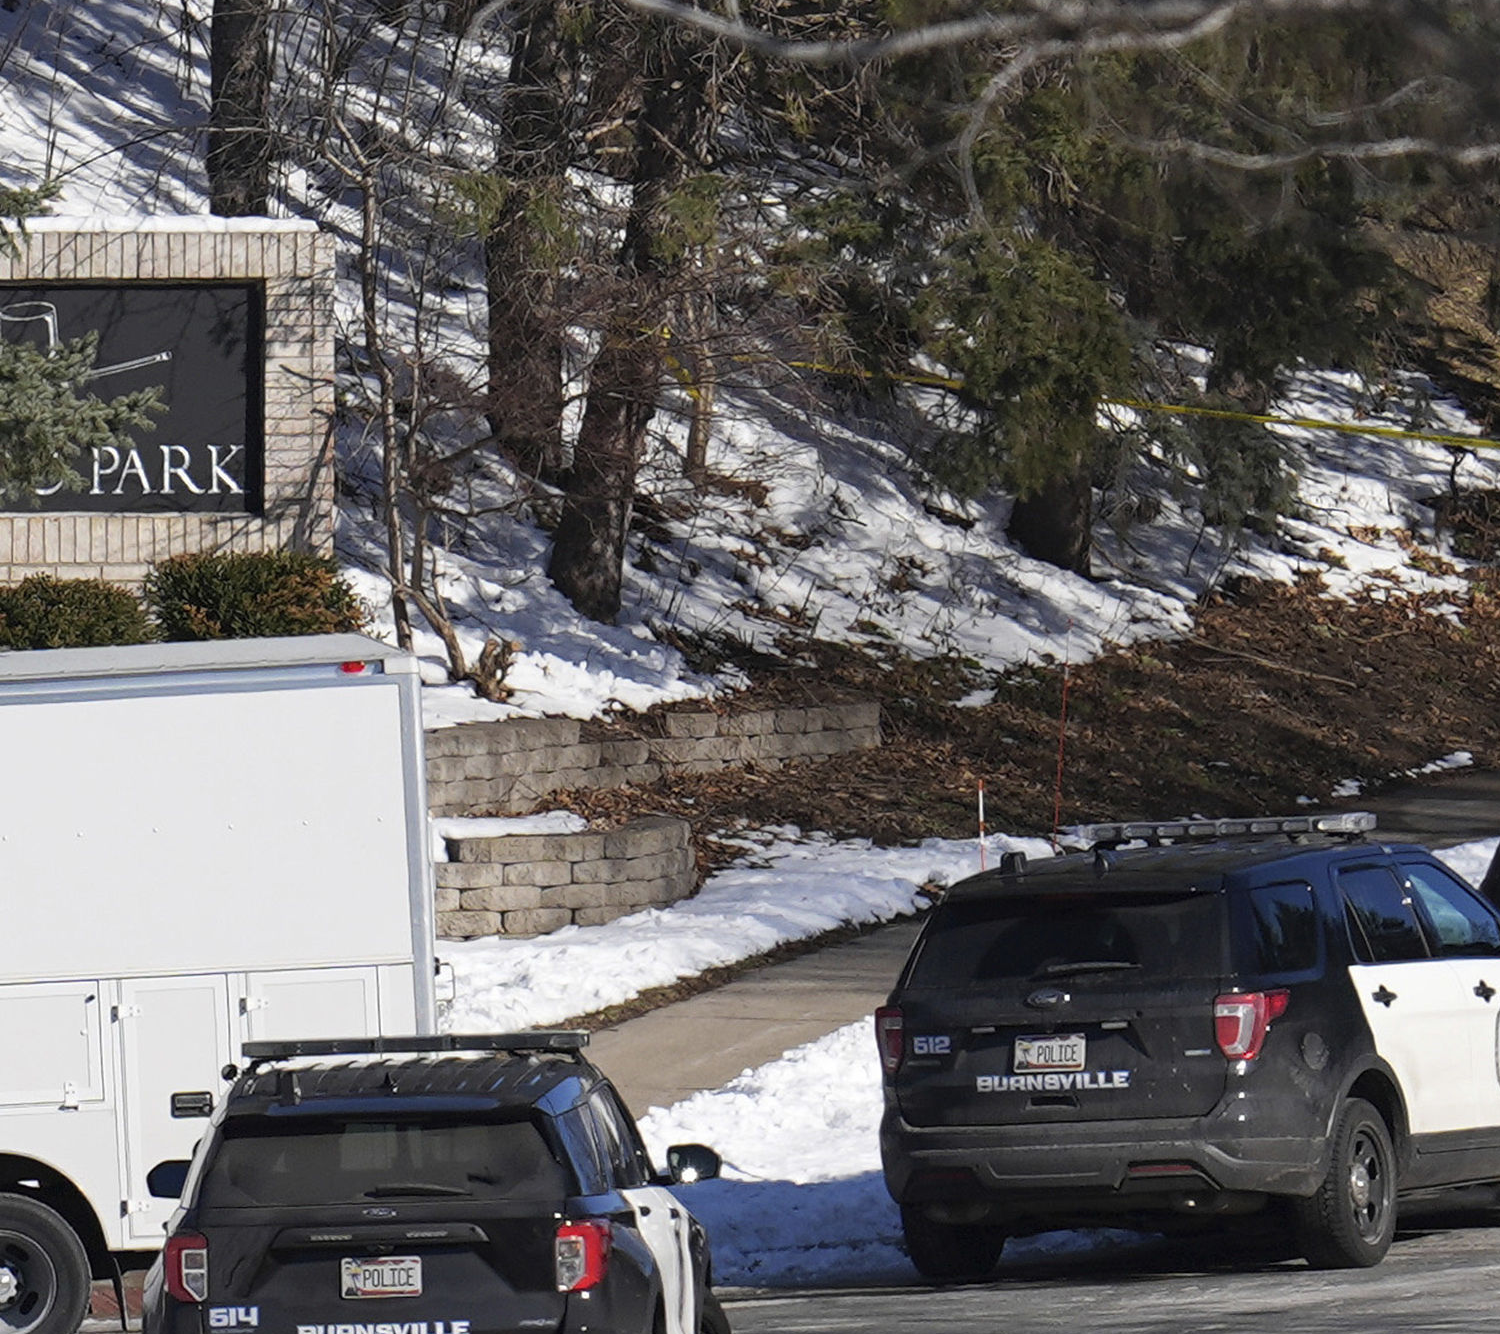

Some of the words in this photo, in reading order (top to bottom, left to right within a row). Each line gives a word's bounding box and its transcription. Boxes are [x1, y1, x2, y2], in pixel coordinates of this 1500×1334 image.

[89, 444, 247, 496] PARK
[1036, 1043, 1079, 1064] POLICE
[976, 1070, 1131, 1093] BURNSVILLE
[362, 1267, 416, 1289] POLICE
